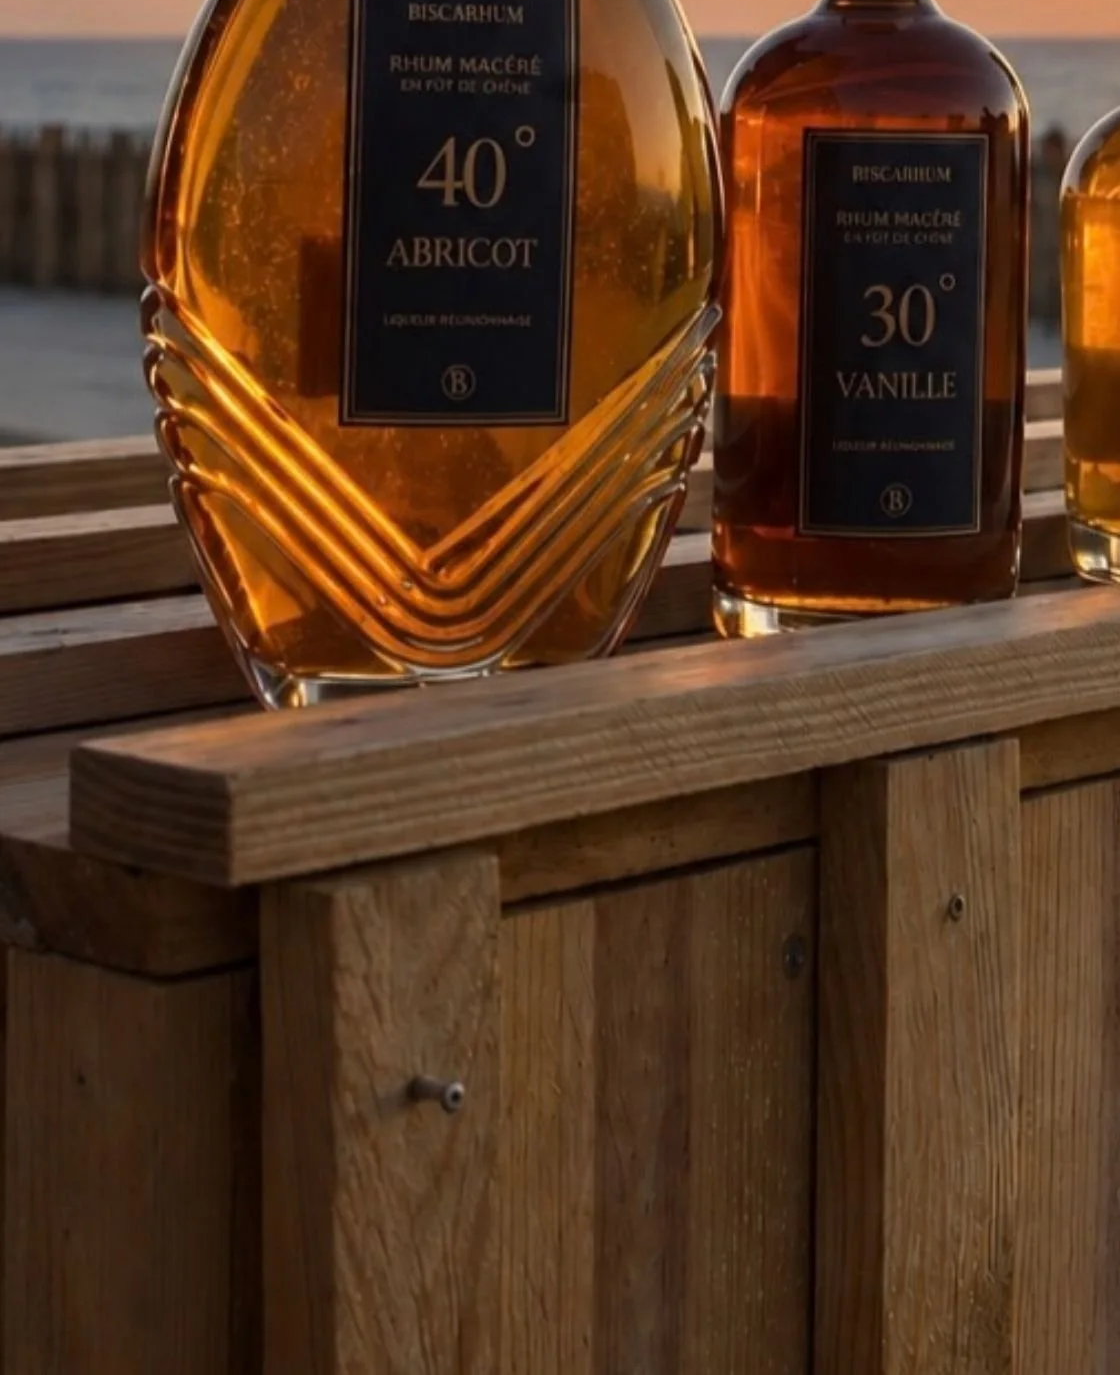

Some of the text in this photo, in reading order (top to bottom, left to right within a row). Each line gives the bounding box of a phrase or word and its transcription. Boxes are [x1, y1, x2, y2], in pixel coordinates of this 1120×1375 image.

[408, 2, 524, 25] BISCARHUM
[389, 53, 542, 76] RHUM MACÉRÉ
[416, 125, 536, 208] 40°
[852, 165, 952, 183] BISCARHUM
[836, 210, 889, 226] RHUM
[386, 236, 539, 268] ABRICOT
[859, 273, 956, 348] 30°
[835, 370, 957, 400] VANILLE
